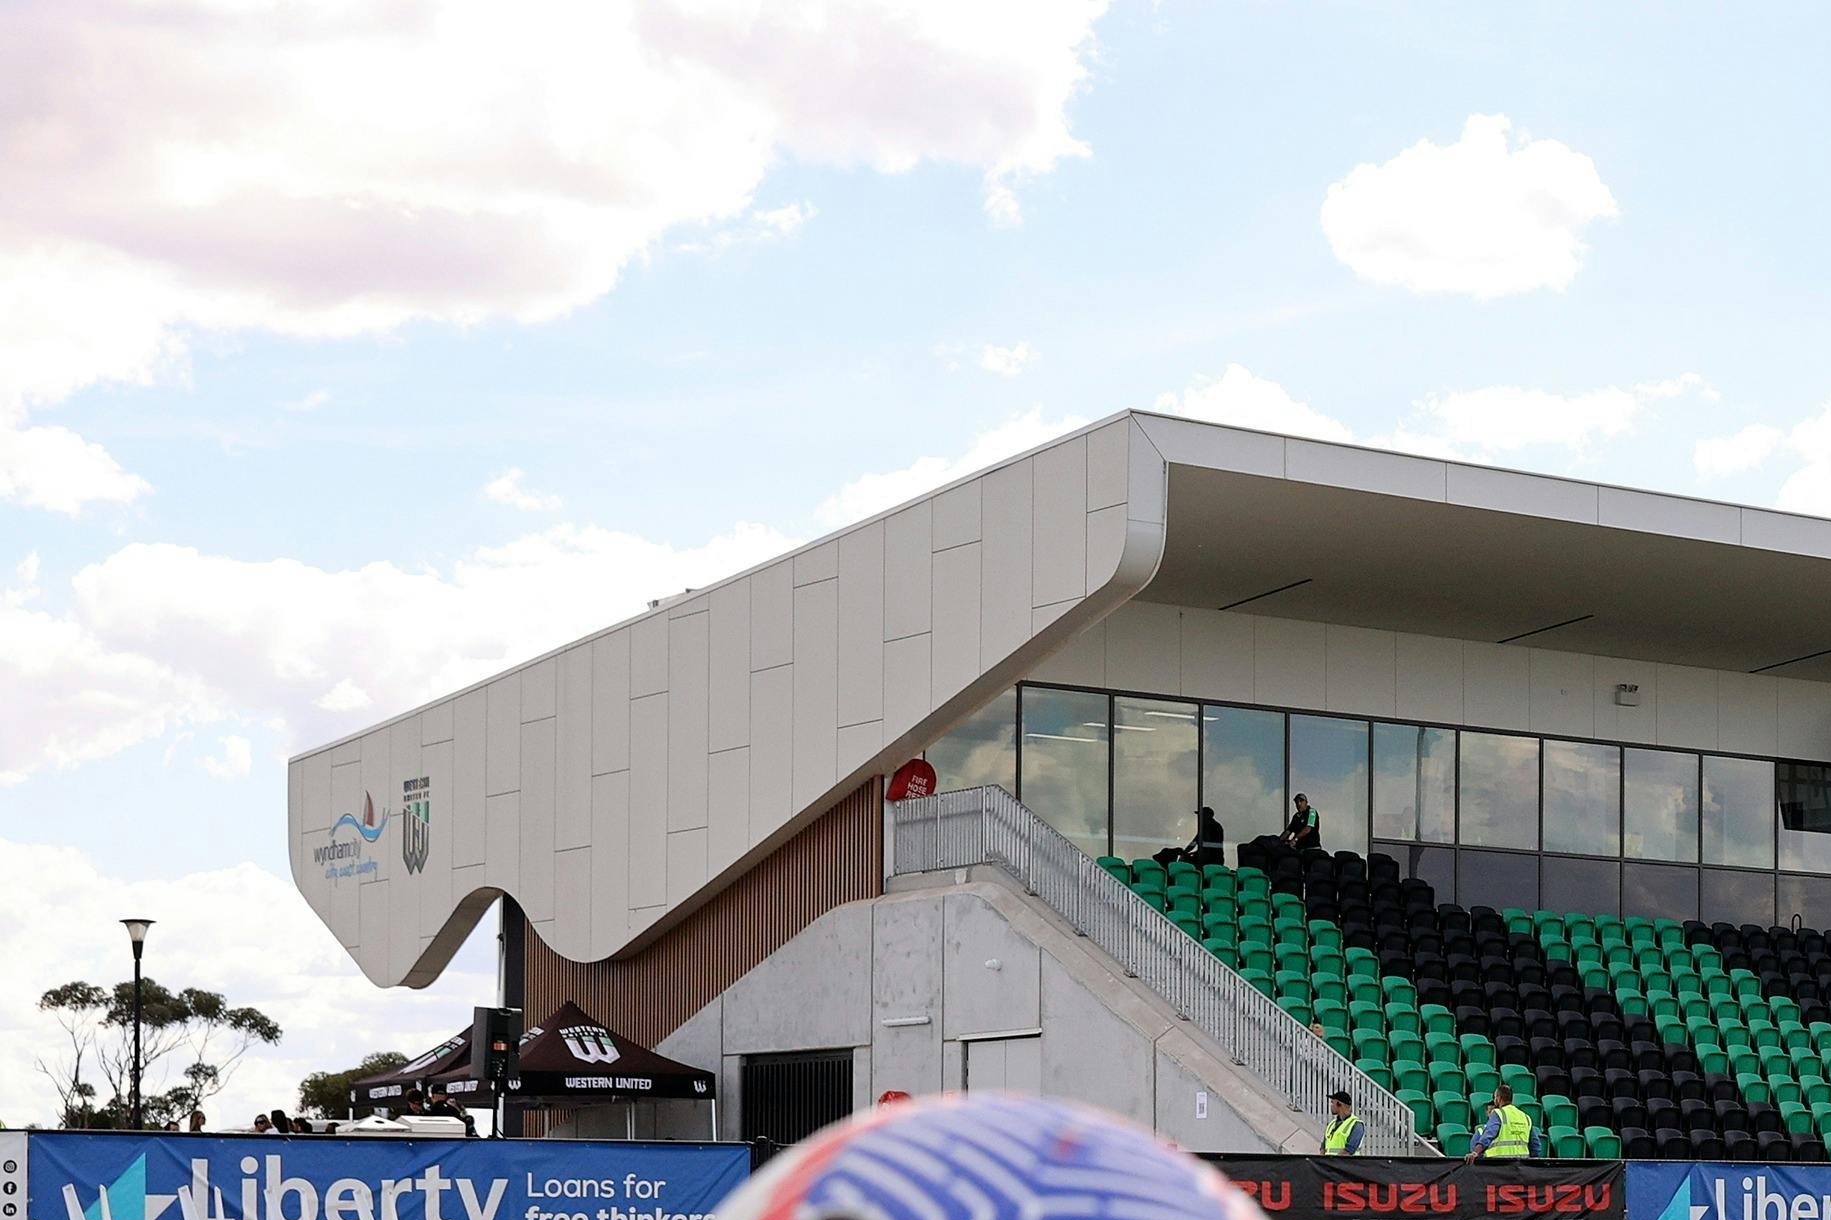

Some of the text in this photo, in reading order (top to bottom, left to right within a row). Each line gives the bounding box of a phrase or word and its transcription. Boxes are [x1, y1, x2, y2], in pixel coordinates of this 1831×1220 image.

[911, 774, 928, 787] FIRE
[907, 782, 928, 796] HOSE
[565, 1077, 652, 1090] WESTERN UNITED
[527, 1172, 667, 1199] Loans for
[1323, 1182, 1457, 1213] ISUZU
[1486, 1183, 1612, 1213] ISUZU
